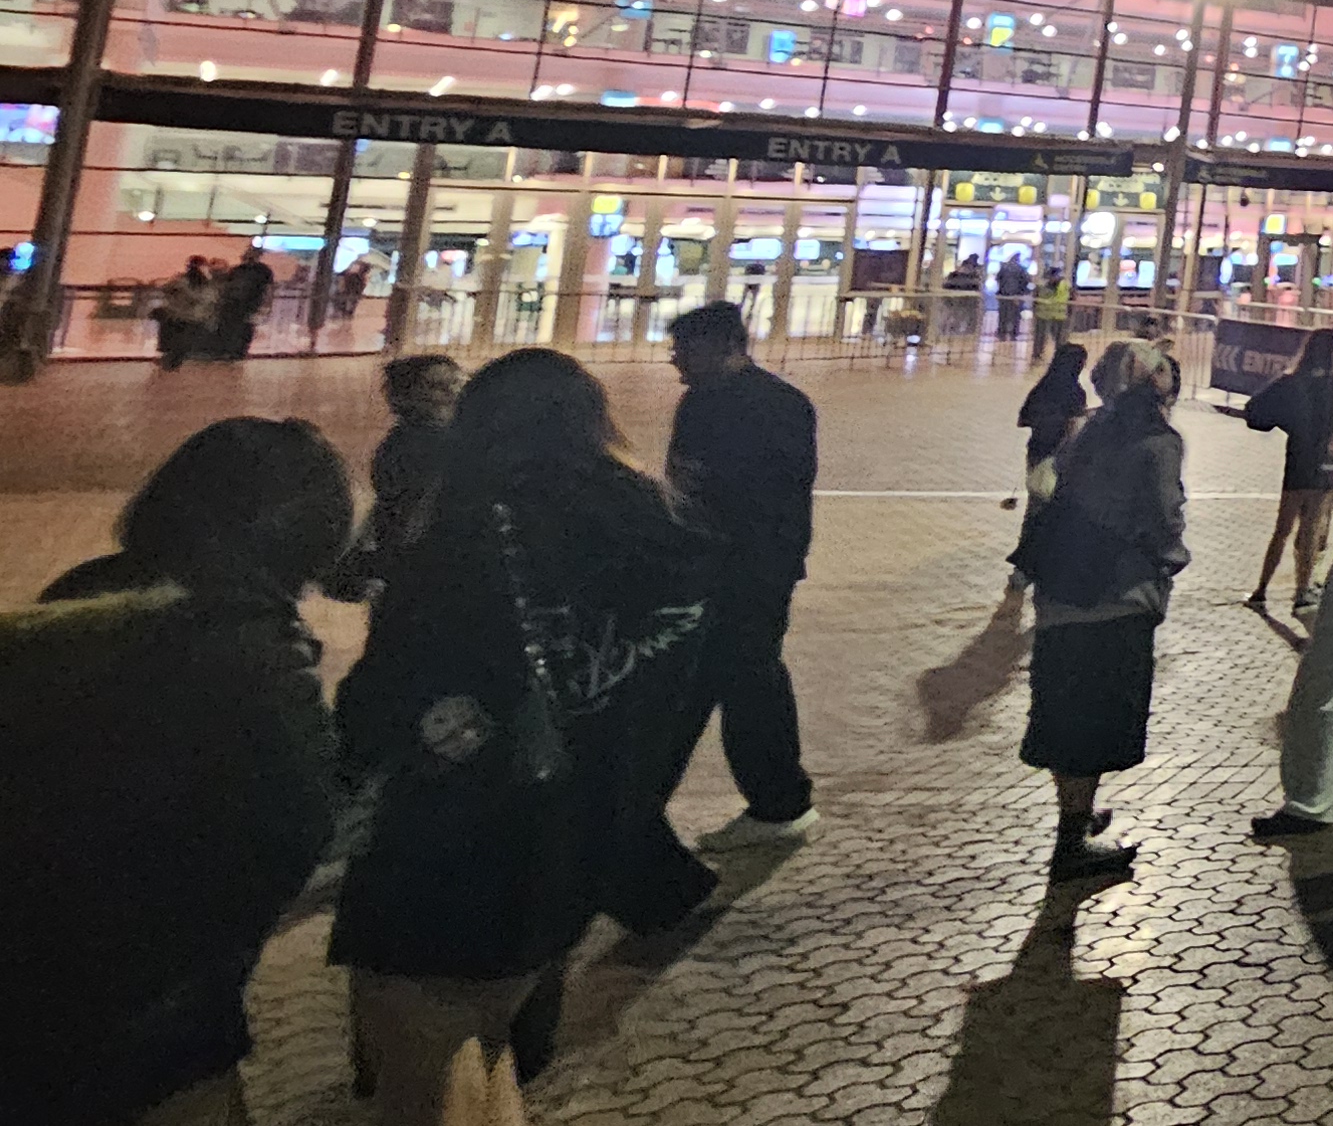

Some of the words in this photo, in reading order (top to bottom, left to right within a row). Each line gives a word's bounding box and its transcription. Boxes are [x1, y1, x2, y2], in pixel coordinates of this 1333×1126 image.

[332, 110, 475, 142] ENTRY
[486, 121, 513, 143] A
[767, 136, 873, 162] ENTRY
[880, 144, 901, 165] A
